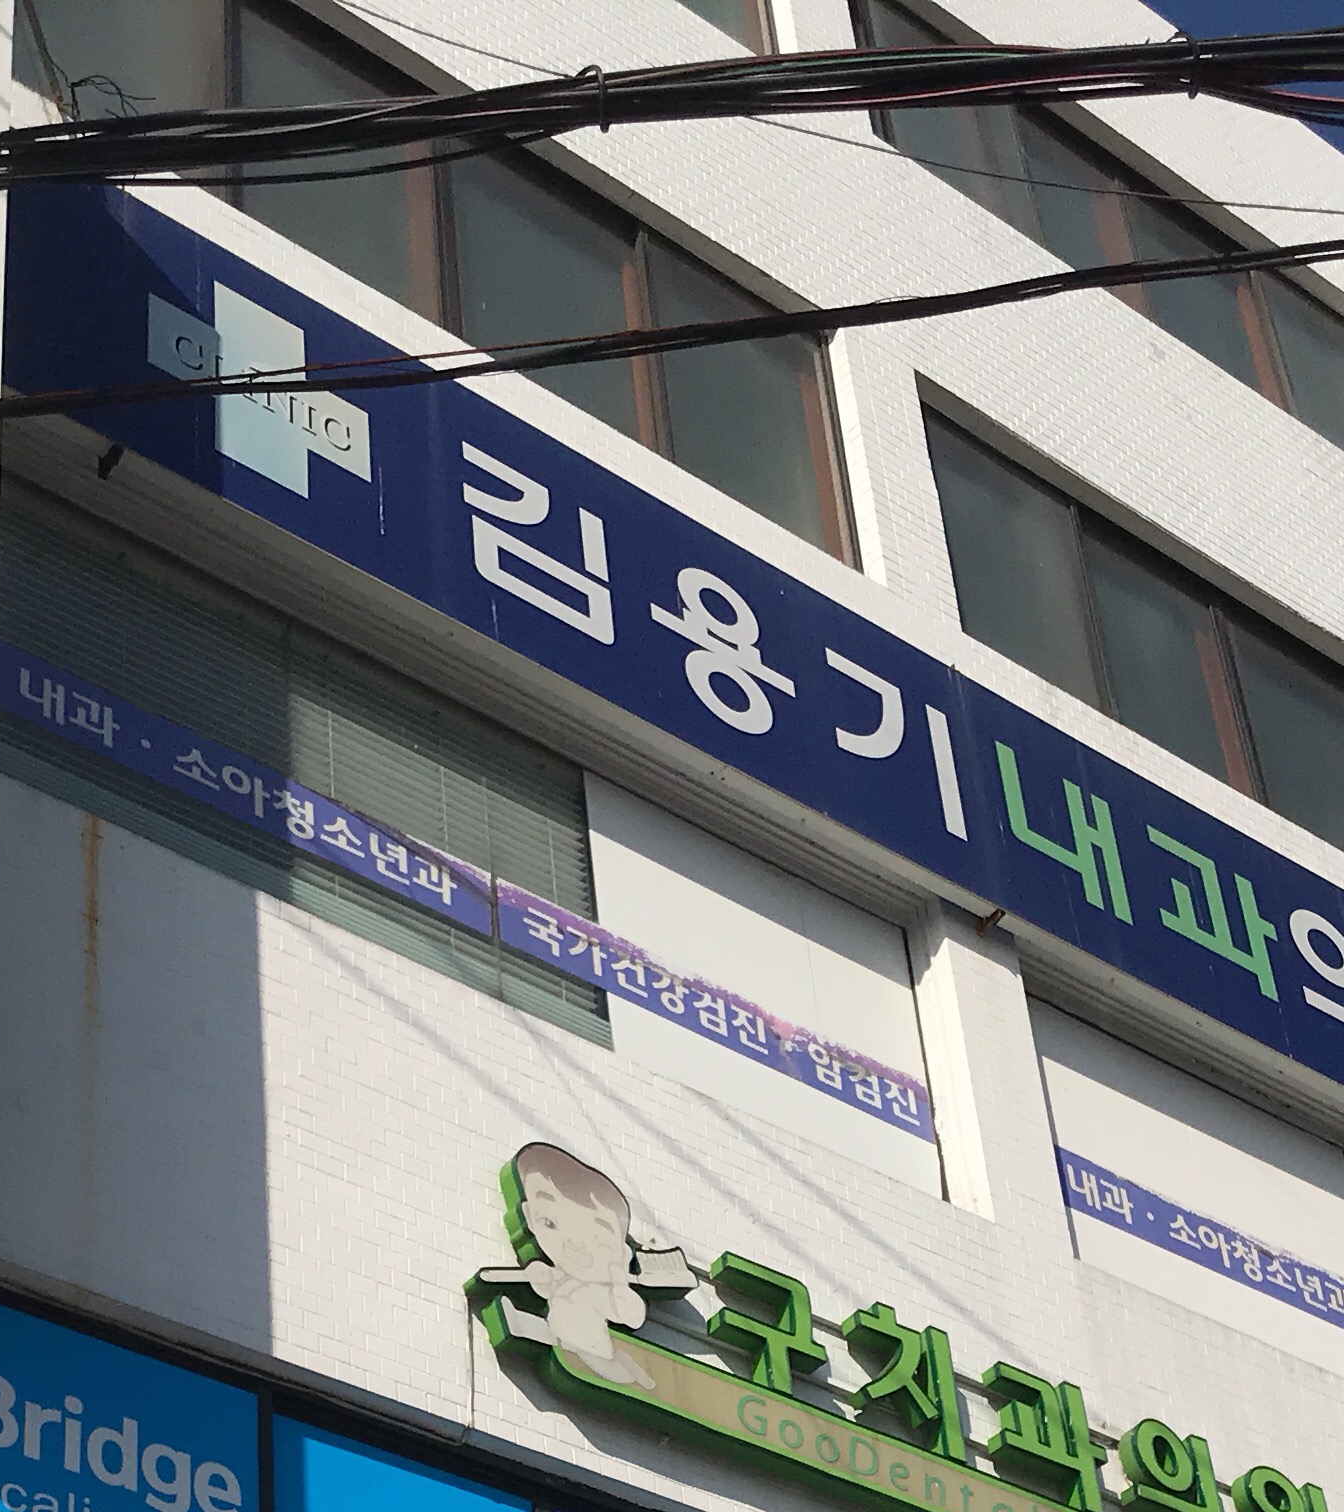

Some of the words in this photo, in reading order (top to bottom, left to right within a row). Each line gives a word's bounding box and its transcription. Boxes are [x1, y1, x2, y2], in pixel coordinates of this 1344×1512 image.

[174, 332, 353, 453] CLINIC
[19, 666, 120, 749] 내과
[172, 747, 458, 906] 소아청소년과
[523, 906, 769, 1056] 국가건강검진
[807, 1040, 922, 1128] 암검진
[1066, 1163, 1134, 1225] 내과
